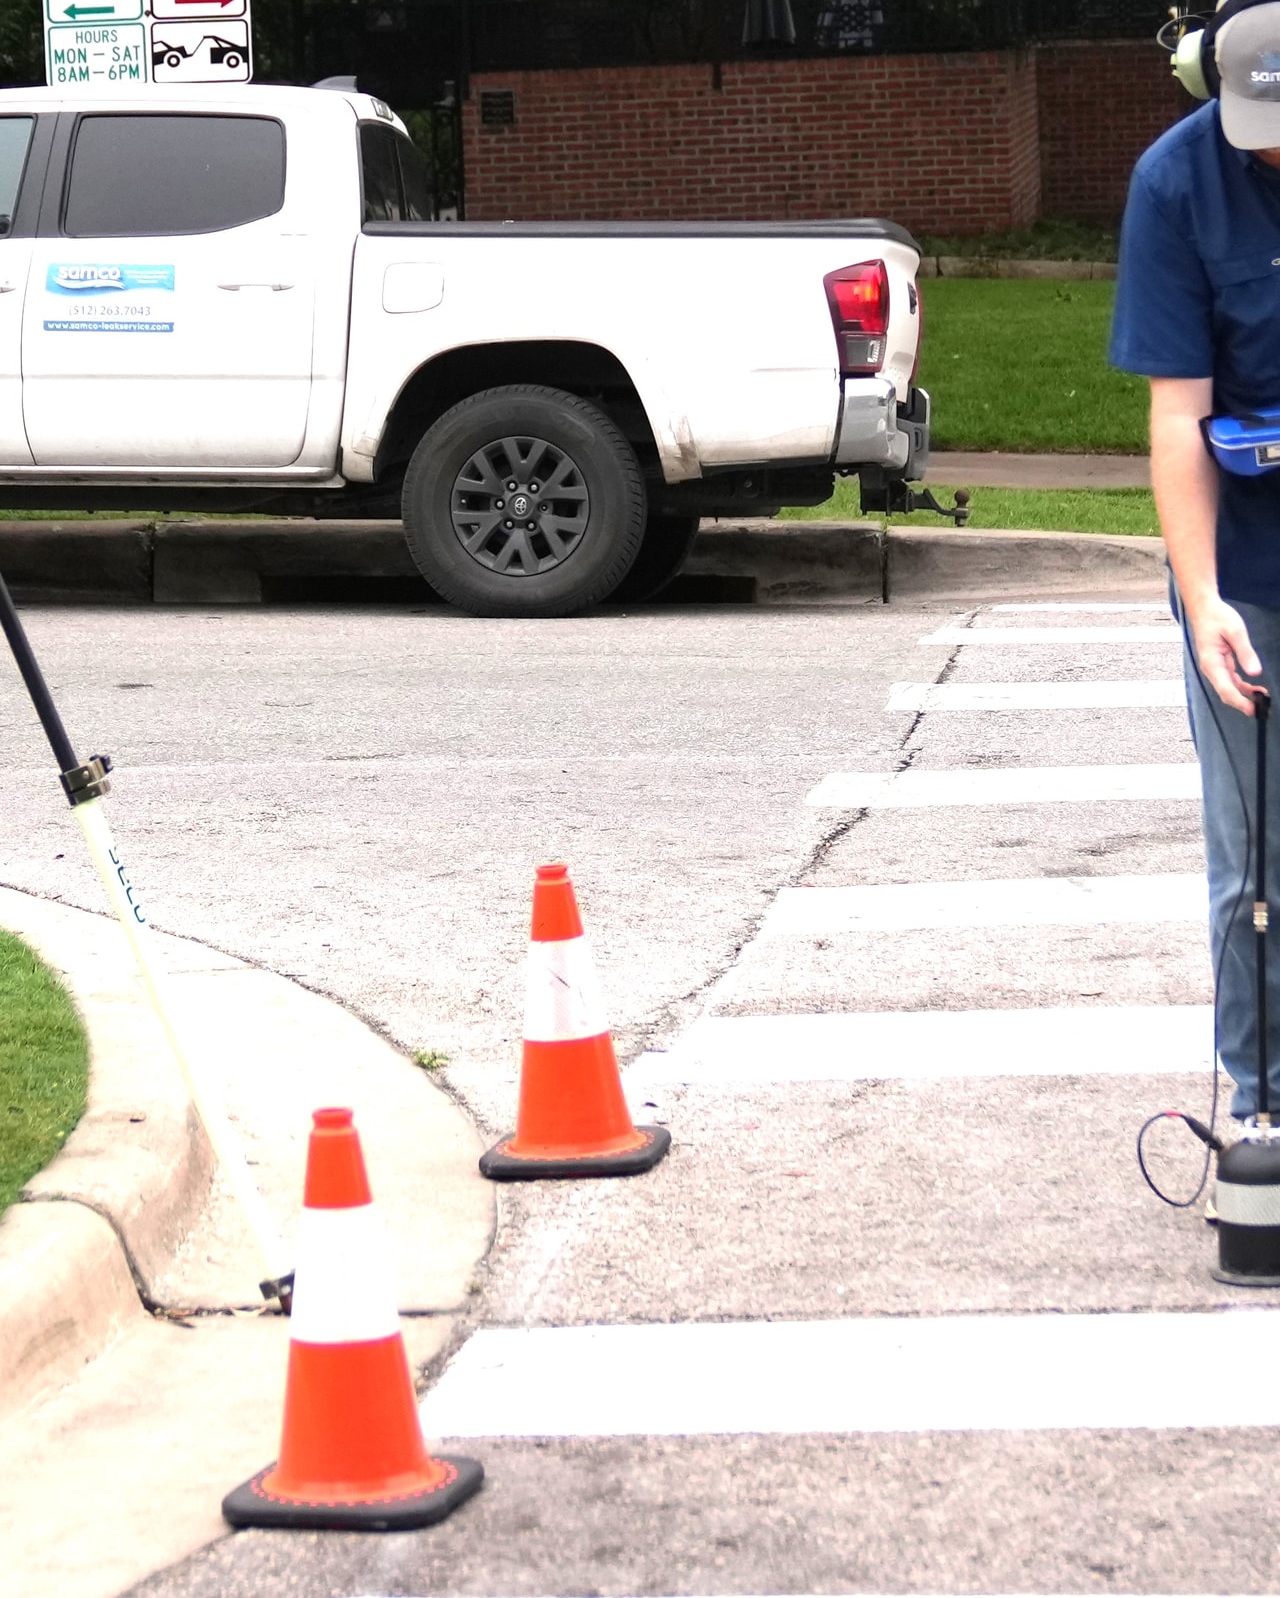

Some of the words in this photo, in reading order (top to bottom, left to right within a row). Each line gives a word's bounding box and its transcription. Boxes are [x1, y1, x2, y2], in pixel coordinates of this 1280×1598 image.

[75, 30, 118, 44] HOURS
[54, 47, 87, 64] MON
[111, 45, 141, 62] SAT
[58, 265, 121, 280] samco
[69, 306, 97, 316] (512)
